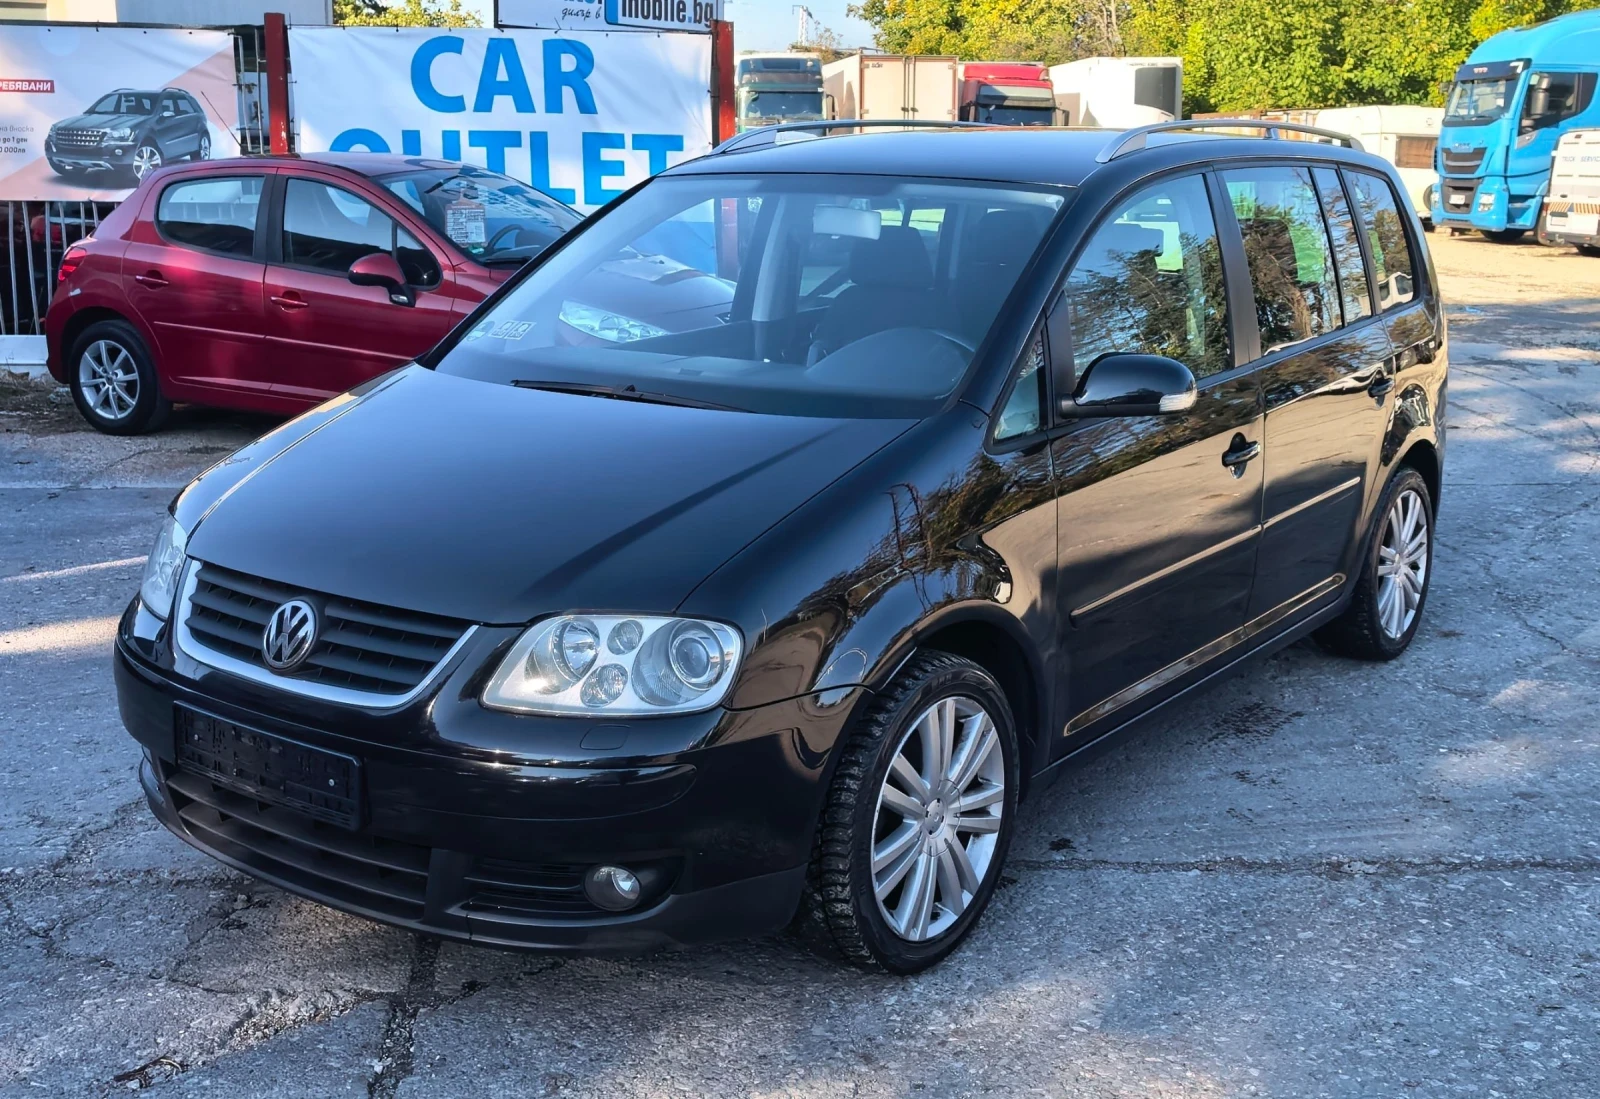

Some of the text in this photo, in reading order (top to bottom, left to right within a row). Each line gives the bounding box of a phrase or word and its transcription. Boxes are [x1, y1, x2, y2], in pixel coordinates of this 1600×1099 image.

[622, 0, 713, 28] mobile.bg
[0, 81, 51, 91] ЕБЯВАНИ
[411, 36, 598, 114] CAR
